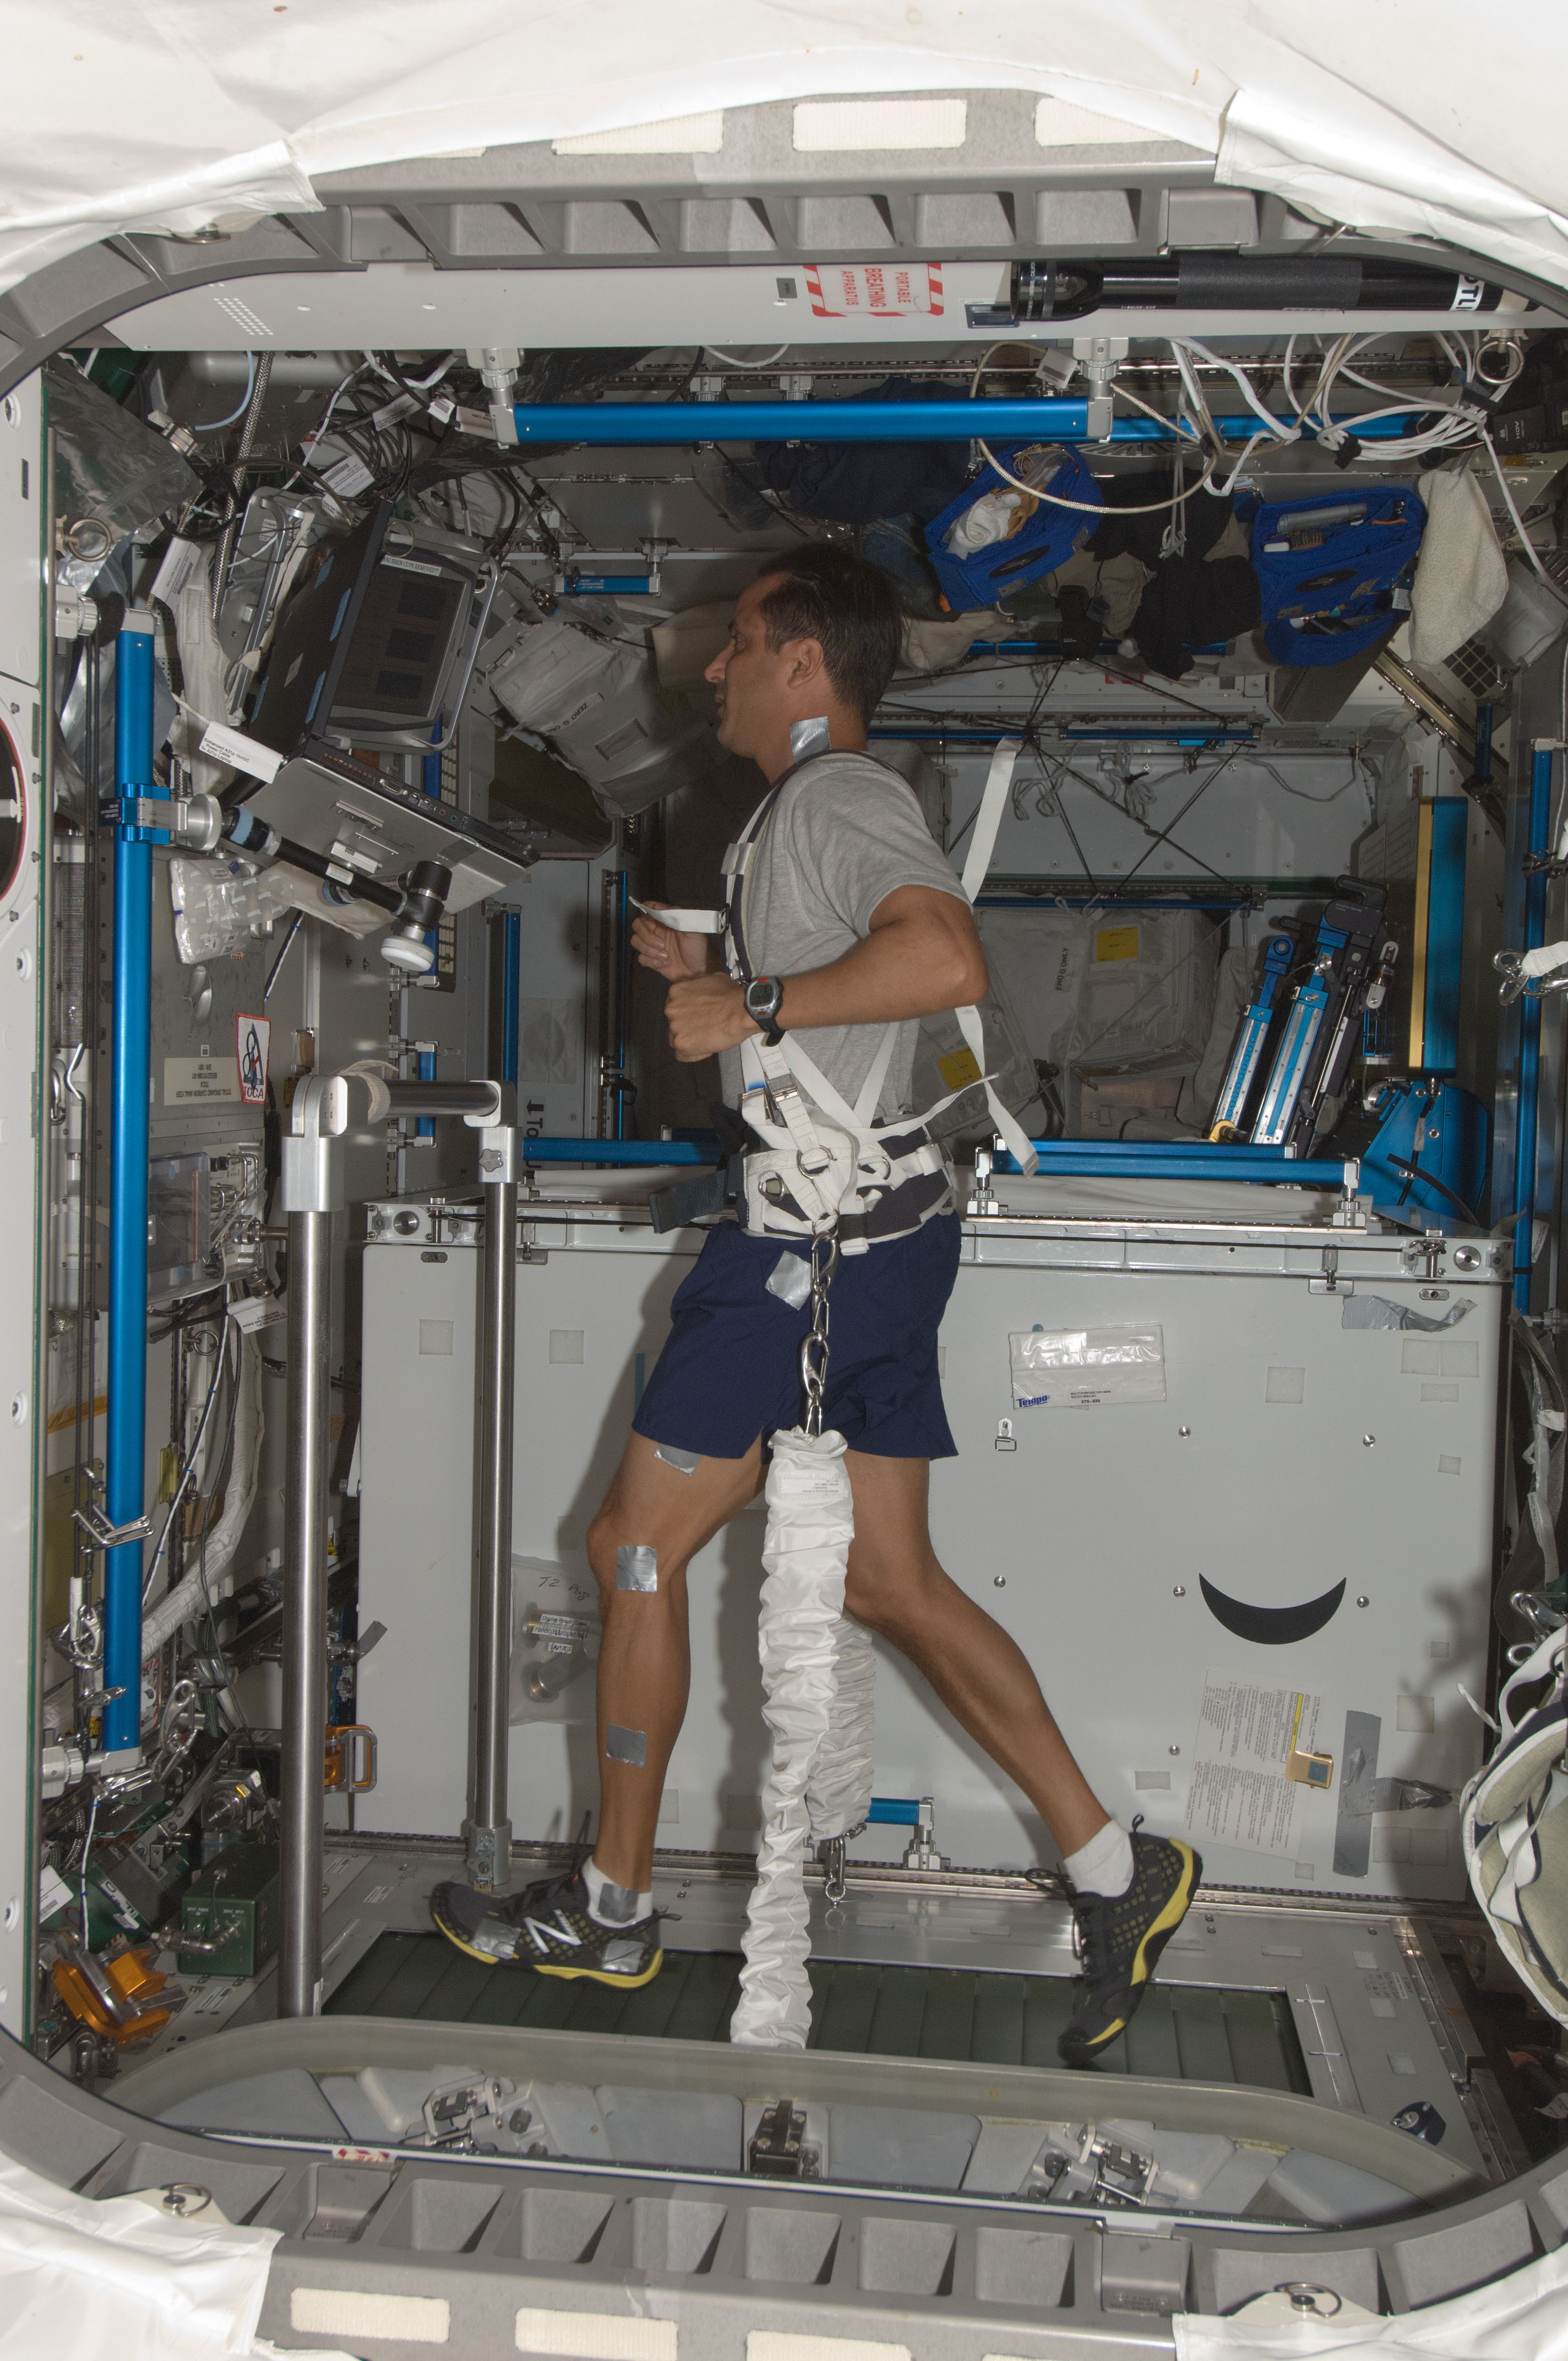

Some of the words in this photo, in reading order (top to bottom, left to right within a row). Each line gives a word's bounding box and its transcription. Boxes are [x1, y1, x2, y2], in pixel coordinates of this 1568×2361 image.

[840, 270, 859, 306] APPARATUS
[864, 268, 886, 308] BREATHING
[895, 271, 911, 304] PORTABLE
[568, 702, 590, 720] ZERO
[203, 737, 225, 751] Enhanced
[205, 742, 219, 753] Power
[218, 749, 231, 759] Cable
[216, 753, 232, 764] Laptop
[1059, 947, 1069, 967] ONLY
[176, 1090, 193, 1098] ANALYZER
[241, 1085, 264, 1098] TOCA
[1015, 1395, 1048, 1408] Tempo
